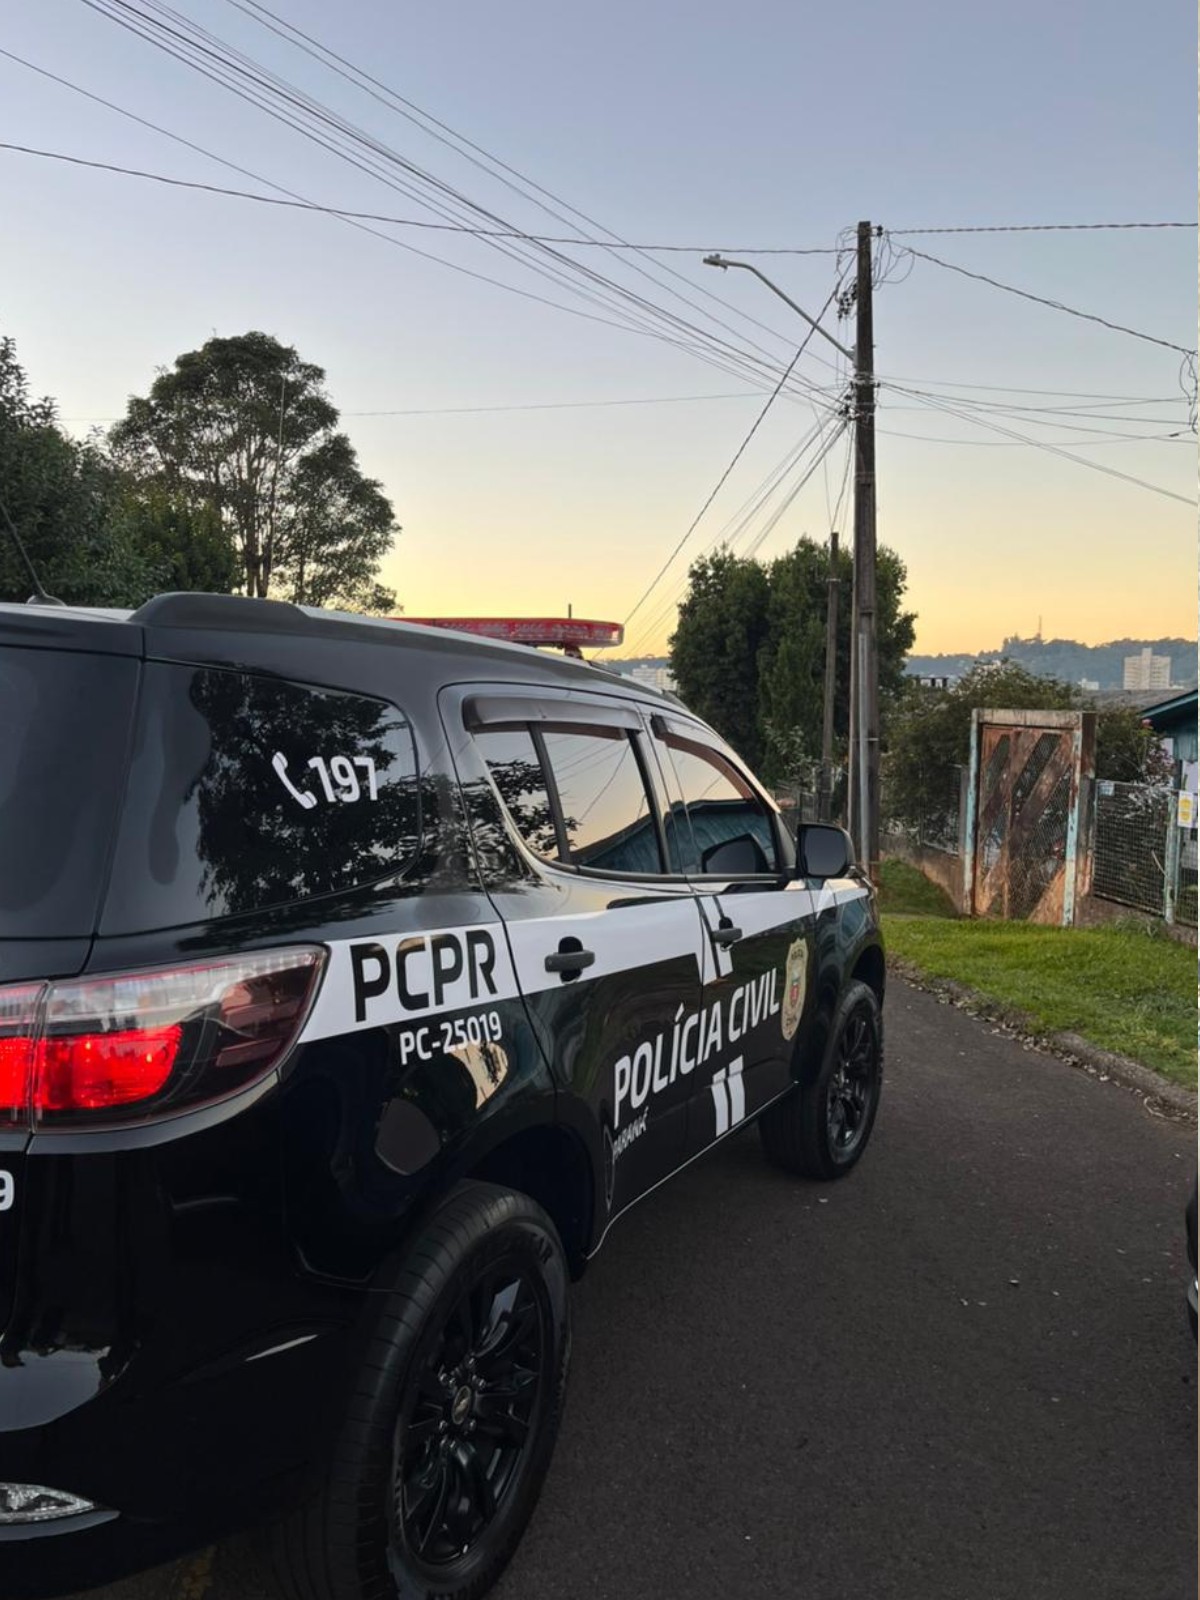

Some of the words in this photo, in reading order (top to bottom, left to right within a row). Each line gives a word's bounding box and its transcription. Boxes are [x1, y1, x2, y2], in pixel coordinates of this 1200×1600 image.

[308, 755, 378, 802] 197
[350, 929, 498, 1022] PCPR
[400, 1011, 503, 1065] PC-25019
[613, 1000, 723, 1131] POLÍCIA
[728, 967, 780, 1043] CIVIL
